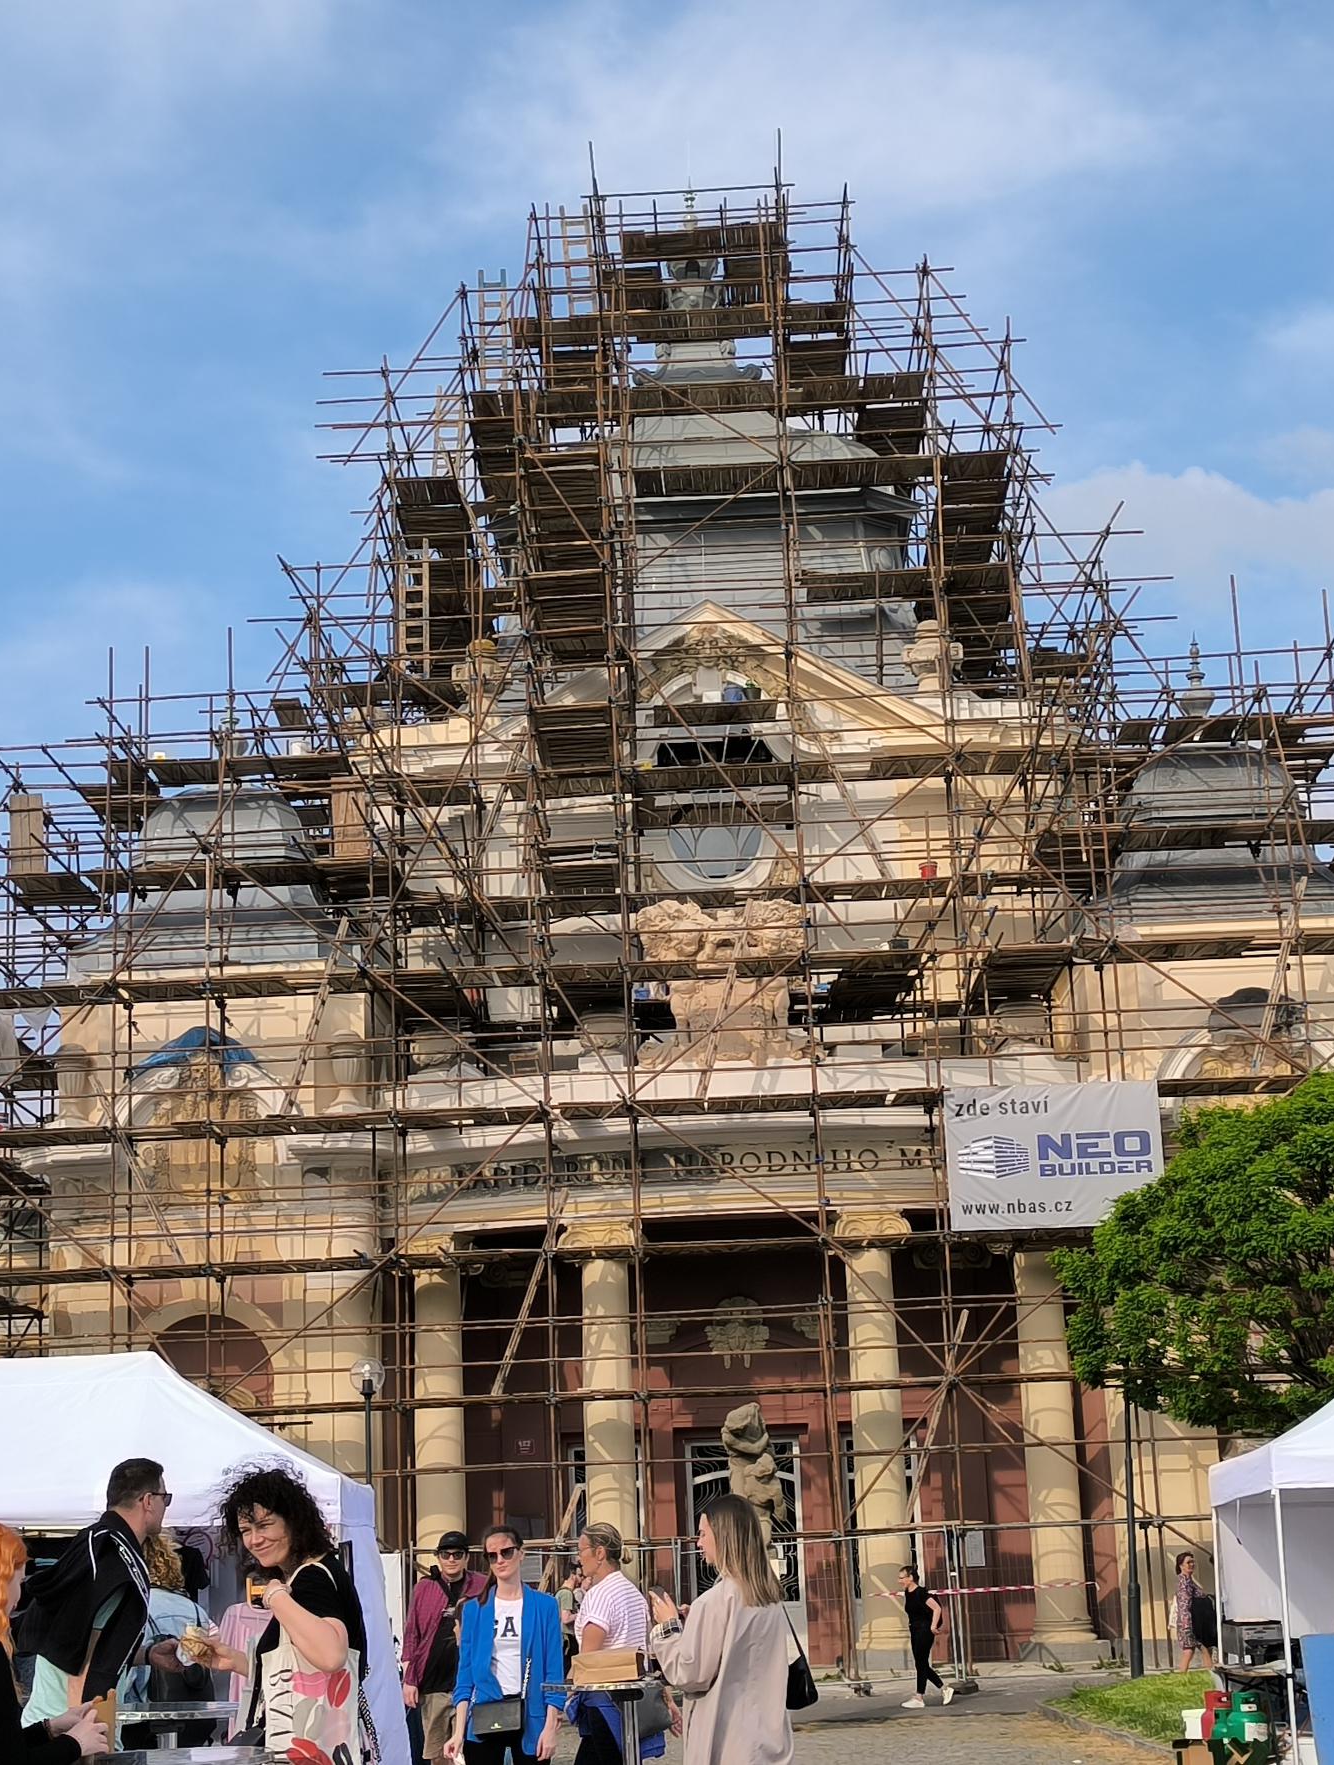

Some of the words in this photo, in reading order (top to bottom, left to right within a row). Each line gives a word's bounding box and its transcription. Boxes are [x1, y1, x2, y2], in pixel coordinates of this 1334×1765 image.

[954, 1098, 990, 1117] zde
[998, 1095, 1049, 1115] staví
[1037, 1130, 1151, 1160] NEO
[1039, 1159, 1153, 1177] BUILDER
[961, 1198, 1073, 1215] www.nbas.cz
